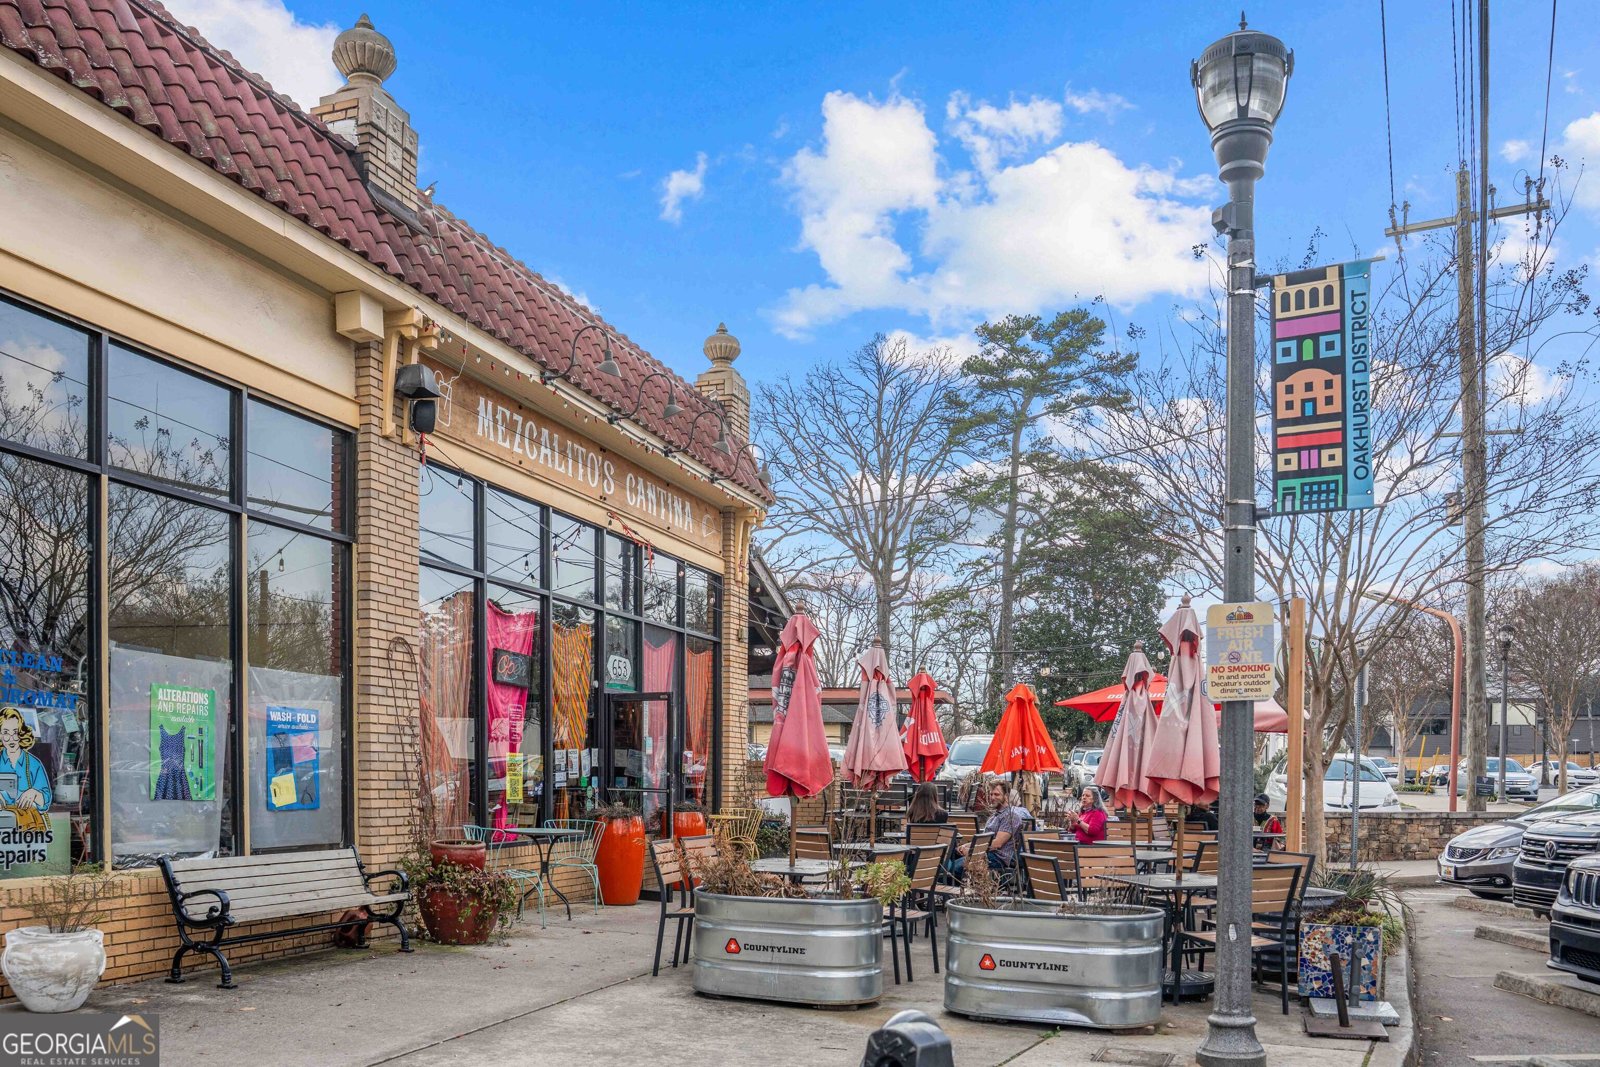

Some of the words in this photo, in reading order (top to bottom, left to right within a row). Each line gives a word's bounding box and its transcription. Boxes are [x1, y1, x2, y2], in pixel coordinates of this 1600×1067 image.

[1351, 289, 1368, 373] DISTRICT
[1351, 379, 1370, 480] OAKHURST
[476, 395, 616, 496] MEZCALITO'S
[625, 472, 694, 533] CANTINA
[1216, 625, 1264, 640] FRESH
[1228, 639, 1254, 651] AIR
[612, 659, 628, 677] 653
[1211, 666, 1225, 674] NO
[1228, 664, 1271, 673] SMOKING
[1241, 672, 1266, 680] around
[1243, 679, 1271, 687] outdoor
[158, 688, 209, 705] ALTERATIONS
[157, 701, 174, 713] AND
[176, 703, 209, 717] REPAIRS
[269, 711, 292, 722] WASH
[296, 713, 317, 724] FOLD
[0, 826, 53, 845] ations
